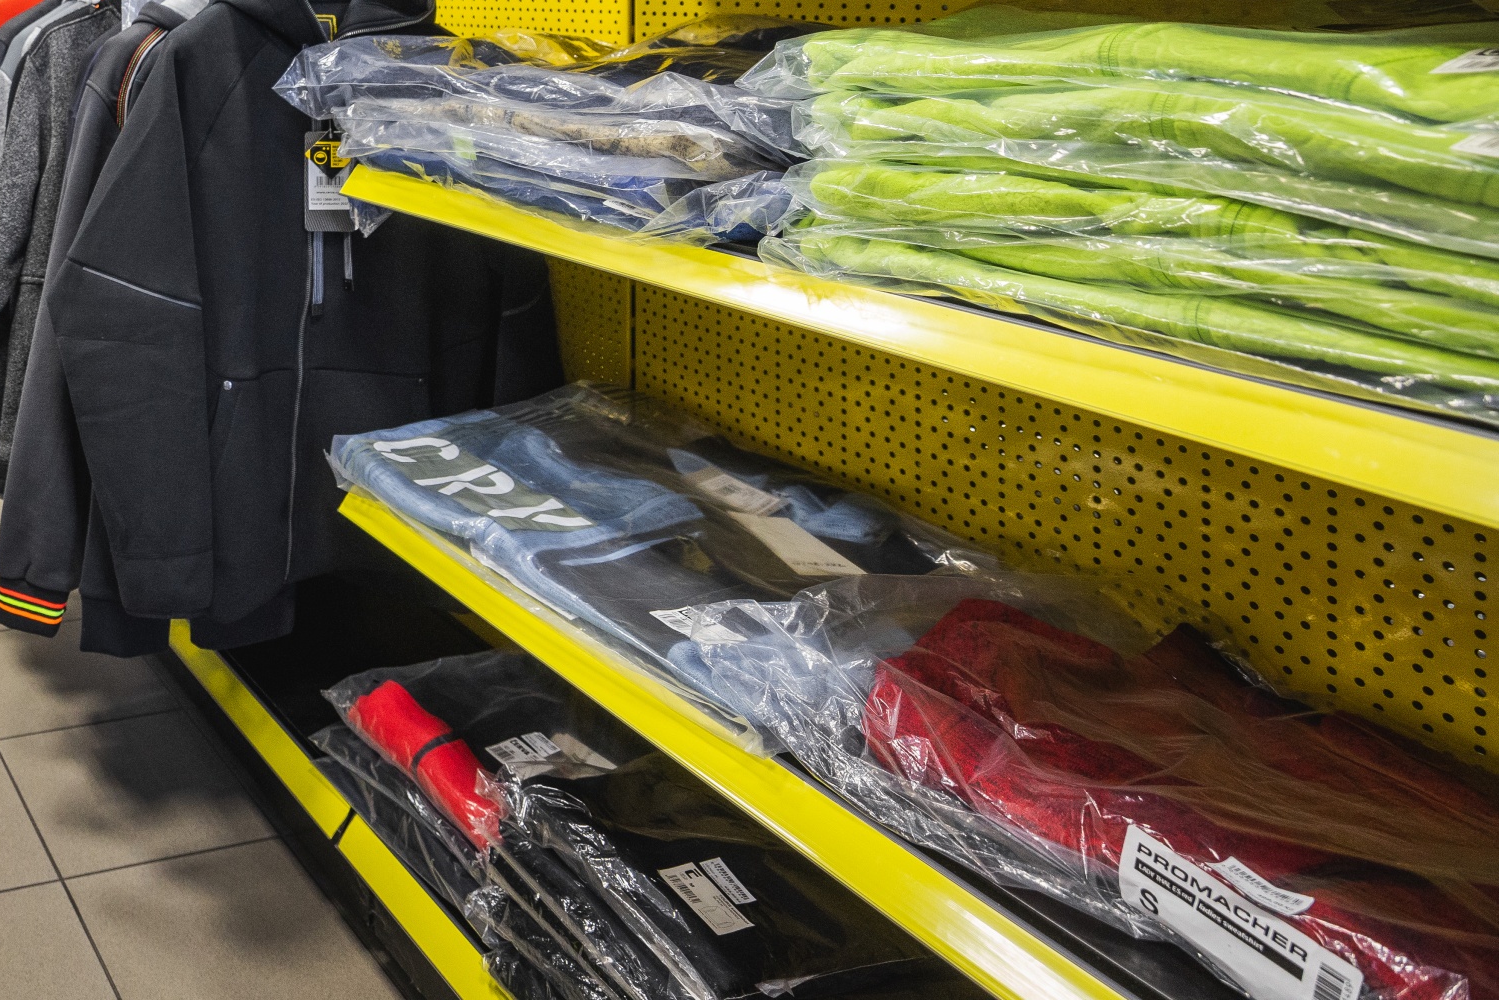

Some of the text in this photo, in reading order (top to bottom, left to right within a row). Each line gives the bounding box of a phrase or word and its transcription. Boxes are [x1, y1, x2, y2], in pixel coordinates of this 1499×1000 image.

[373, 437, 593, 527] CRV
[1138, 863, 1155, 879] LADY
[1136, 842, 1307, 962] PROMACHER
[1139, 887, 1159, 915] S
[1198, 903, 1264, 953] ladies sweatshirt
